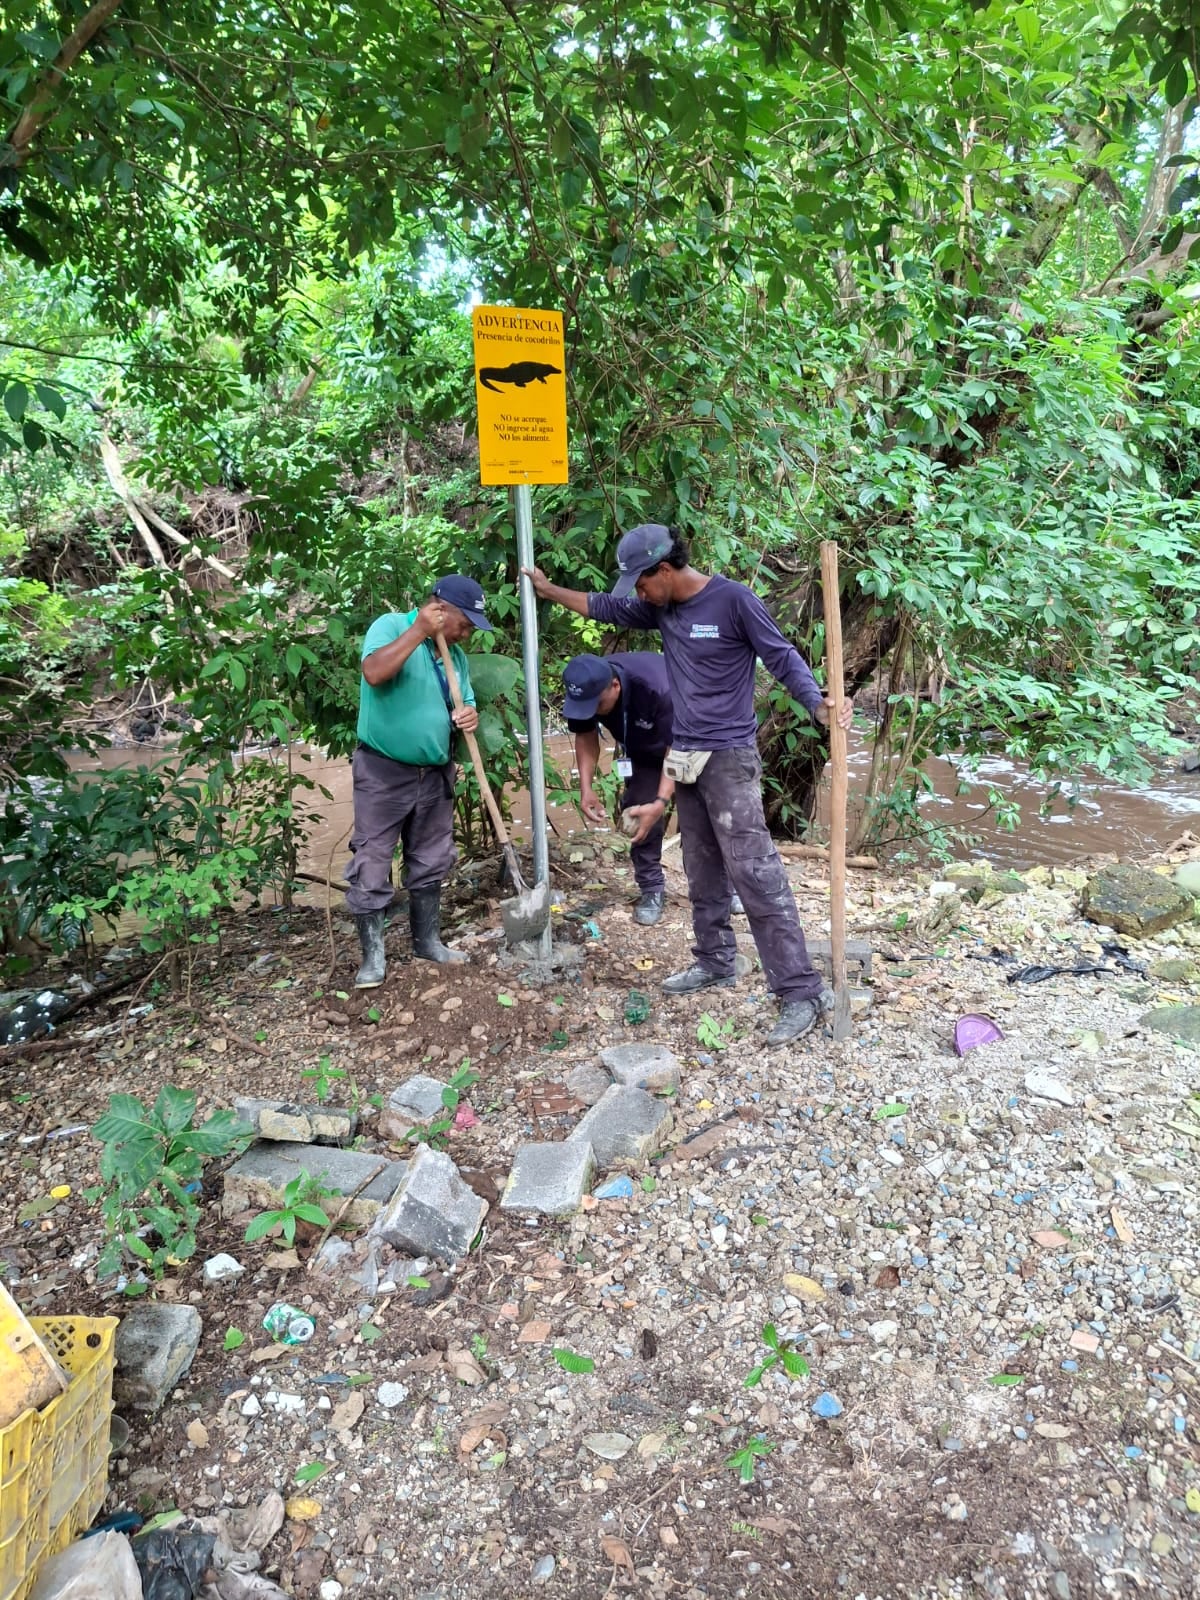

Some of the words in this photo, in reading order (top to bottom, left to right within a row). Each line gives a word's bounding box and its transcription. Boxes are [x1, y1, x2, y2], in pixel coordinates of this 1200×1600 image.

[478, 314, 560, 332] ADVERTENCIA
[477, 330, 513, 342] Presencia
[514, 334, 523, 343] de
[493, 423, 505, 432] NO
[506, 425, 530, 433] ingrese
[532, 424, 538, 432] al
